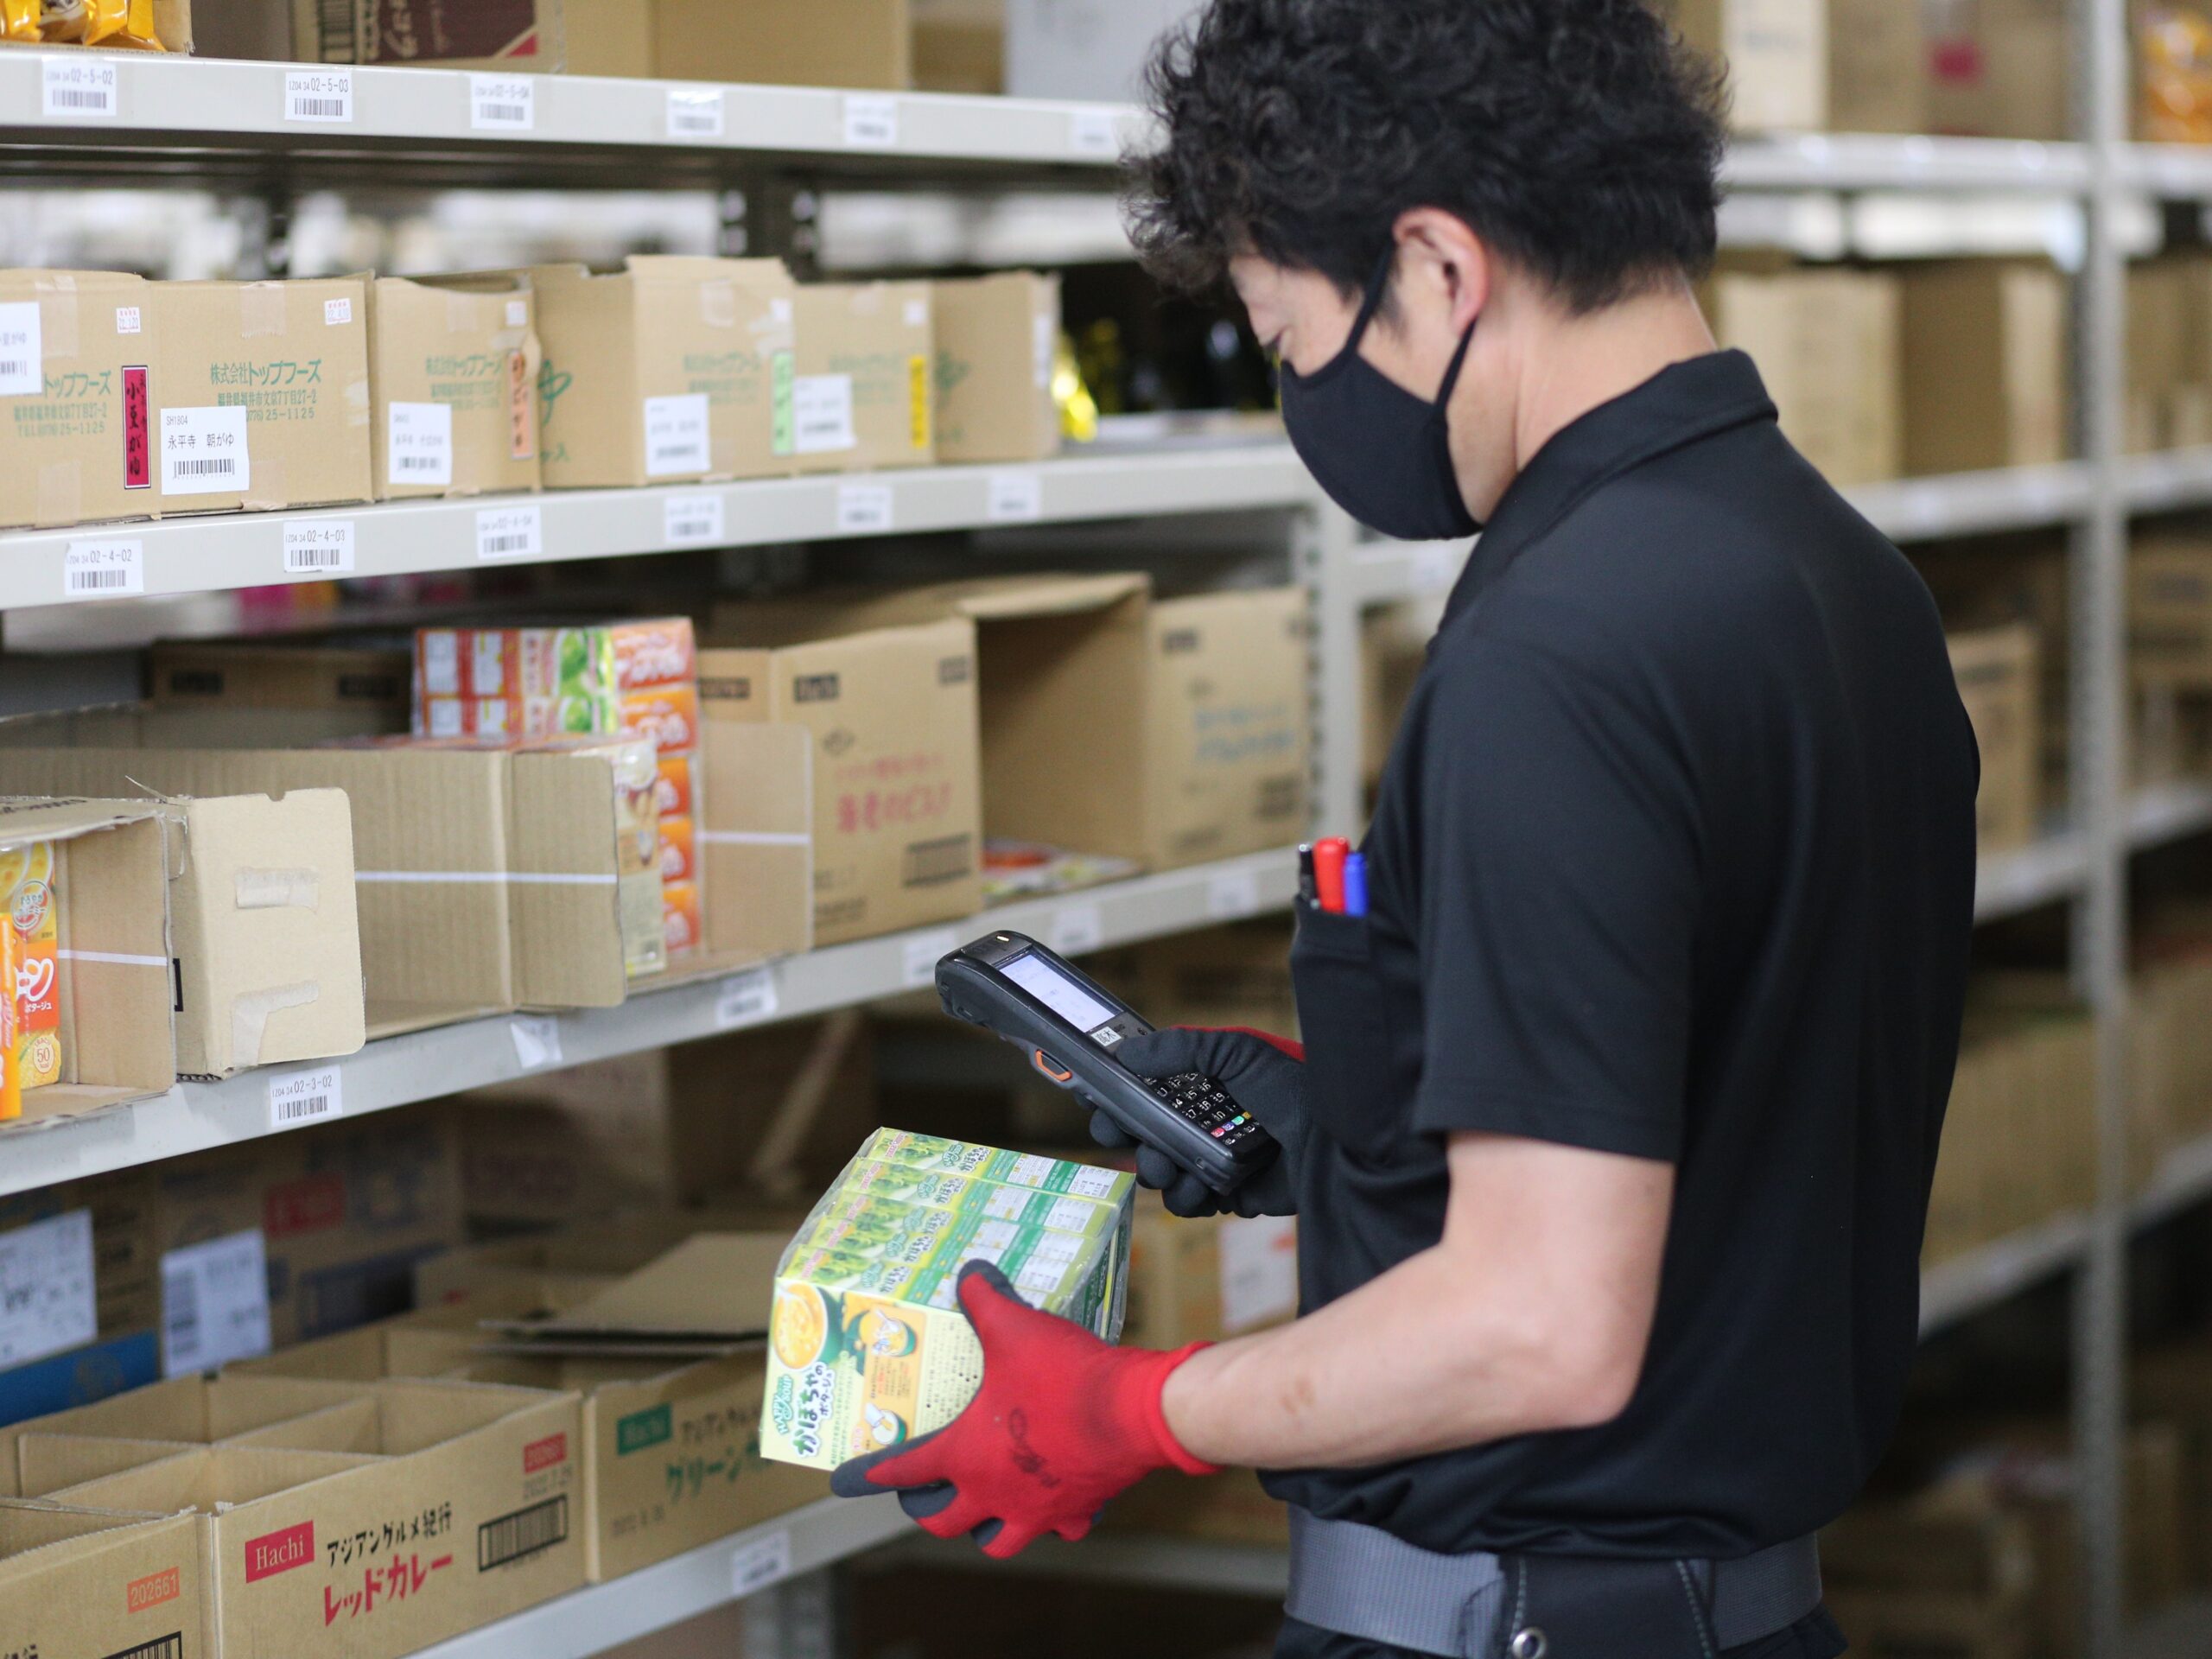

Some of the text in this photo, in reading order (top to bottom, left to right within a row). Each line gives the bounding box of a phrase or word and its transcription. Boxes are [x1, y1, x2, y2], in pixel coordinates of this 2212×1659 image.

[71, 68, 113, 85] 02-5-02
[310, 78, 349, 92] 02-5-03
[210, 359, 322, 385] 株式会社トップフーズ
[168, 432, 234, 449] 永平寺 朝がゆ
[307, 529, 346, 543] 02-4-03
[89, 548, 132, 563] 02-4-02
[36, 1046, 50, 1063] 50
[294, 1074, 332, 1094] 02-3-02
[773, 1376, 793, 1434] HAPPY SOUP
[819, 1372, 833, 1415] ポタージュ
[793, 1365, 824, 1455] かぼちゃの
[327, 1501, 453, 1567] アジアングルメ紀行
[255, 1534, 305, 1571] Hachi
[130, 1573, 178, 1608] 202661
[324, 1554, 454, 1628] レッドカレー
